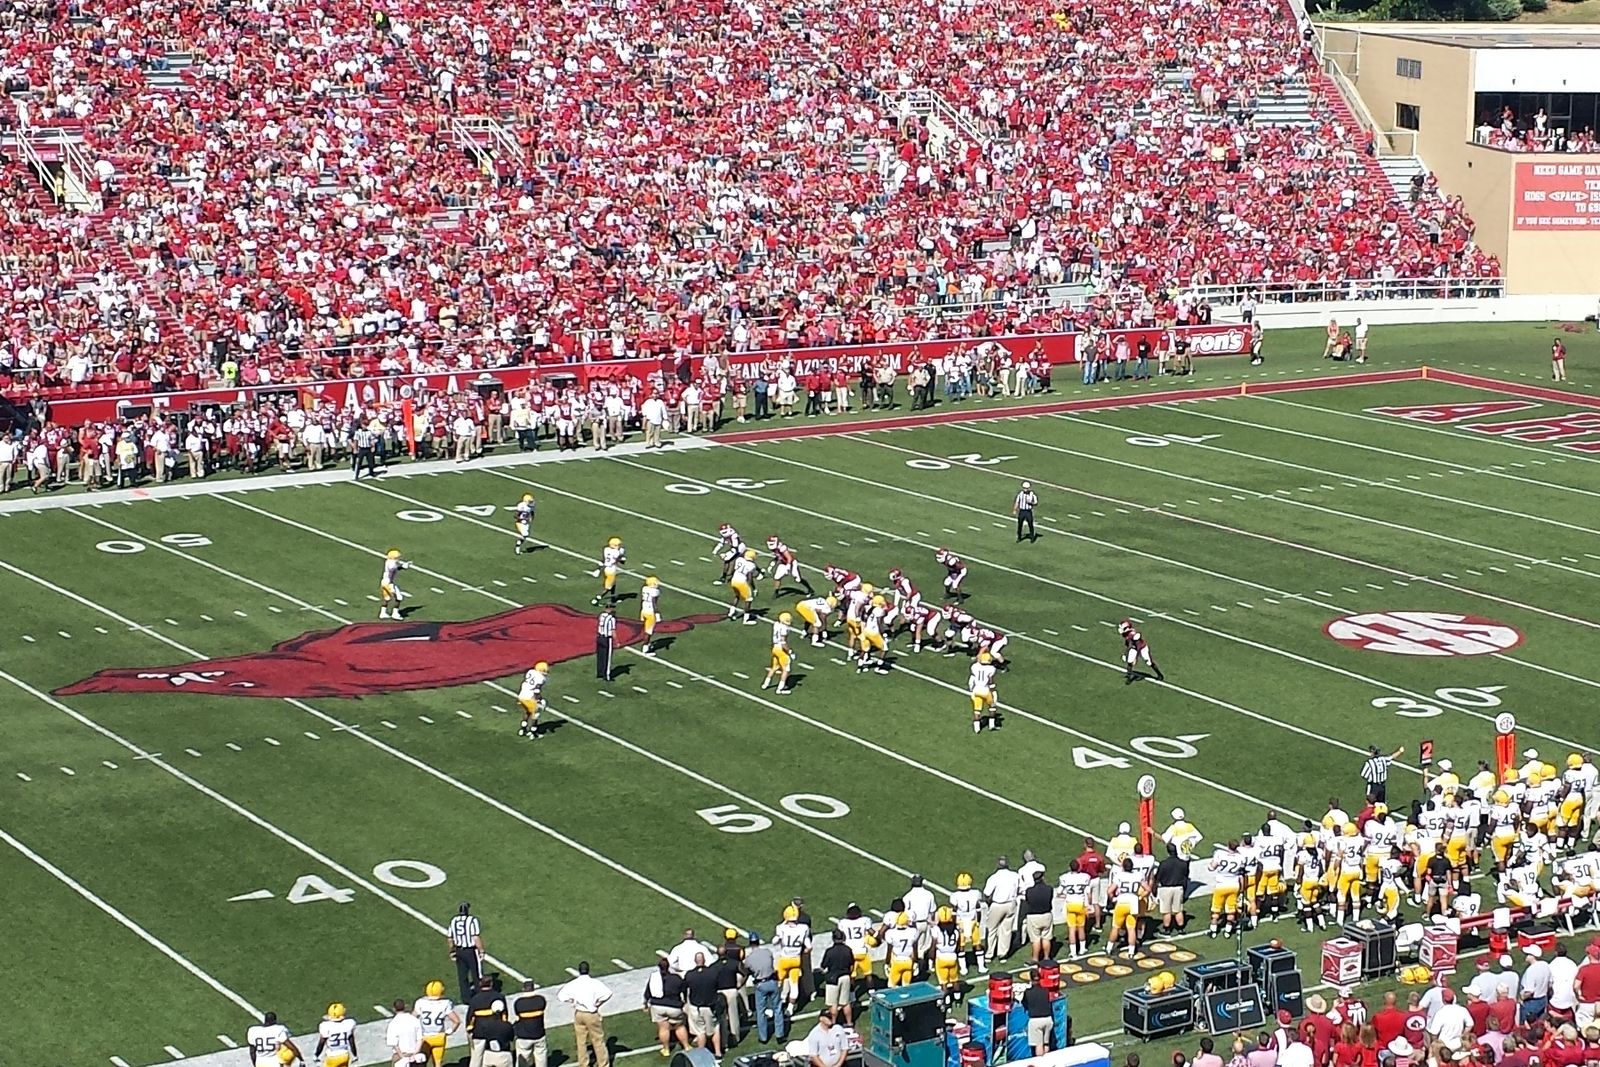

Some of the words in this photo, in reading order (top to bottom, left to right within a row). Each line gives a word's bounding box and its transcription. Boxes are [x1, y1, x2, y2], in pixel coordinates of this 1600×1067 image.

[1558, 165, 1583, 176] GAME
[1524, 191, 1546, 202] HOGS
[1371, 687, 1502, 718] 30
[1072, 736, 1199, 769] 40
[1421, 742, 1433, 759] 2
[695, 793, 852, 834] 50
[1501, 813, 1516, 825] 49
[1429, 817, 1445, 830] 52
[1374, 832, 1391, 846] 96
[1347, 845, 1363, 859] 34
[1220, 859, 1238, 874] 92
[1573, 864, 1591, 878] 30
[286, 859, 448, 904] 40
[1523, 872, 1536, 885] 19
[1066, 883, 1086, 895] 33
[1120, 881, 1140, 894] 50
[847, 926, 863, 940] 13
[786, 935, 801, 948] 16
[899, 938, 909, 952] 7
[421, 1011, 445, 1026] 36
[255, 1037, 276, 1053] 85
[329, 1032, 350, 1047] 31
